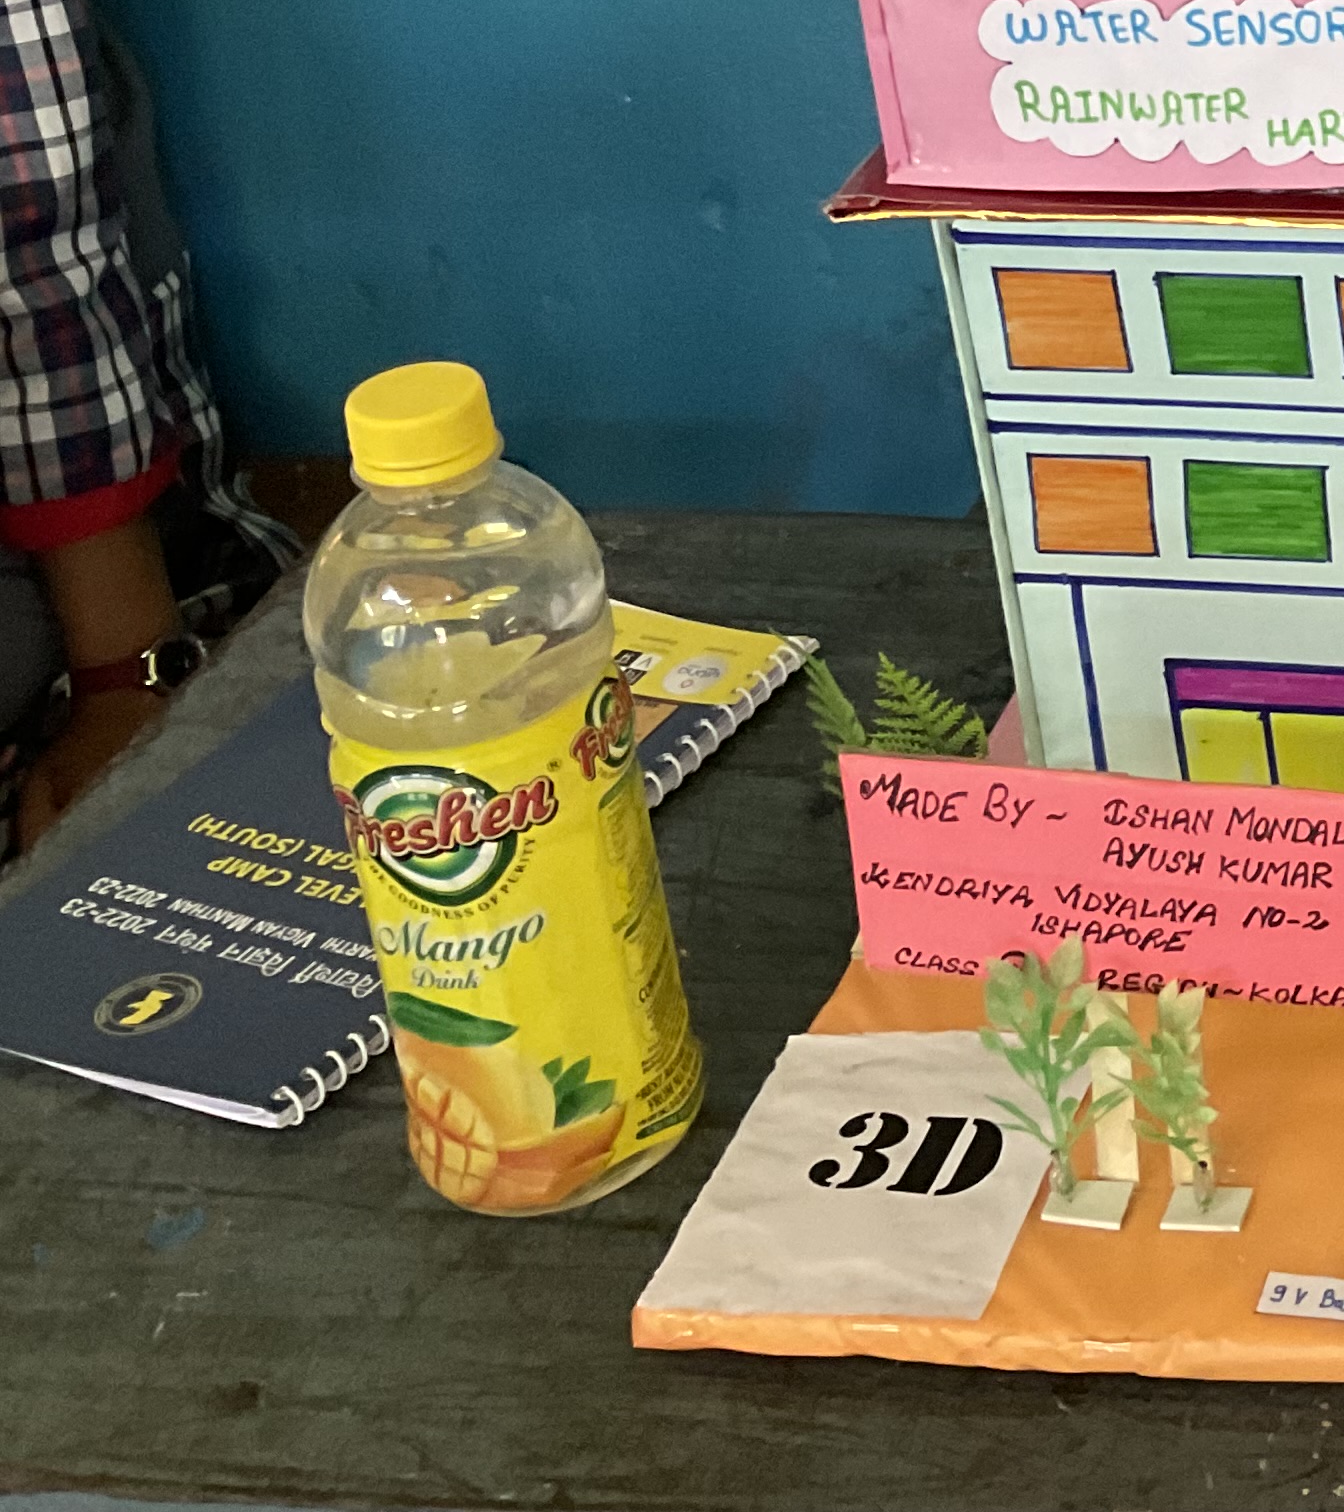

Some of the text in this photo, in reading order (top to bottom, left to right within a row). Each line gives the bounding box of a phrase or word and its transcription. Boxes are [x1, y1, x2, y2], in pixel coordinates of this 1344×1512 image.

[1005, 7, 1159, 48] WATER
[1014, 79, 1249, 127] RAINWATER
[860, 774, 968, 823] MADE
[982, 783, 1035, 829] BY
[1104, 799, 1213, 835] ISHAN
[187, 813, 305, 857] (SOUTH)
[207, 856, 293, 887] CAMP
[1103, 837, 1334, 890] AYUSH KUMAR
[167, 898, 255, 932] MANTHAN
[861, 862, 1036, 909] KENDRIYA
[1055, 885, 1219, 927] VIDYALAYA
[251, 920, 316, 948] VIGYAN
[378, 914, 545, 971] Mango
[1031, 913, 1194, 953] ISHAPORE
[411, 968, 481, 990] Drink
[894, 947, 981, 977] CLASS
[808, 1112, 1004, 1196] 3D
[1270, 1284, 1287, 1303] 9
